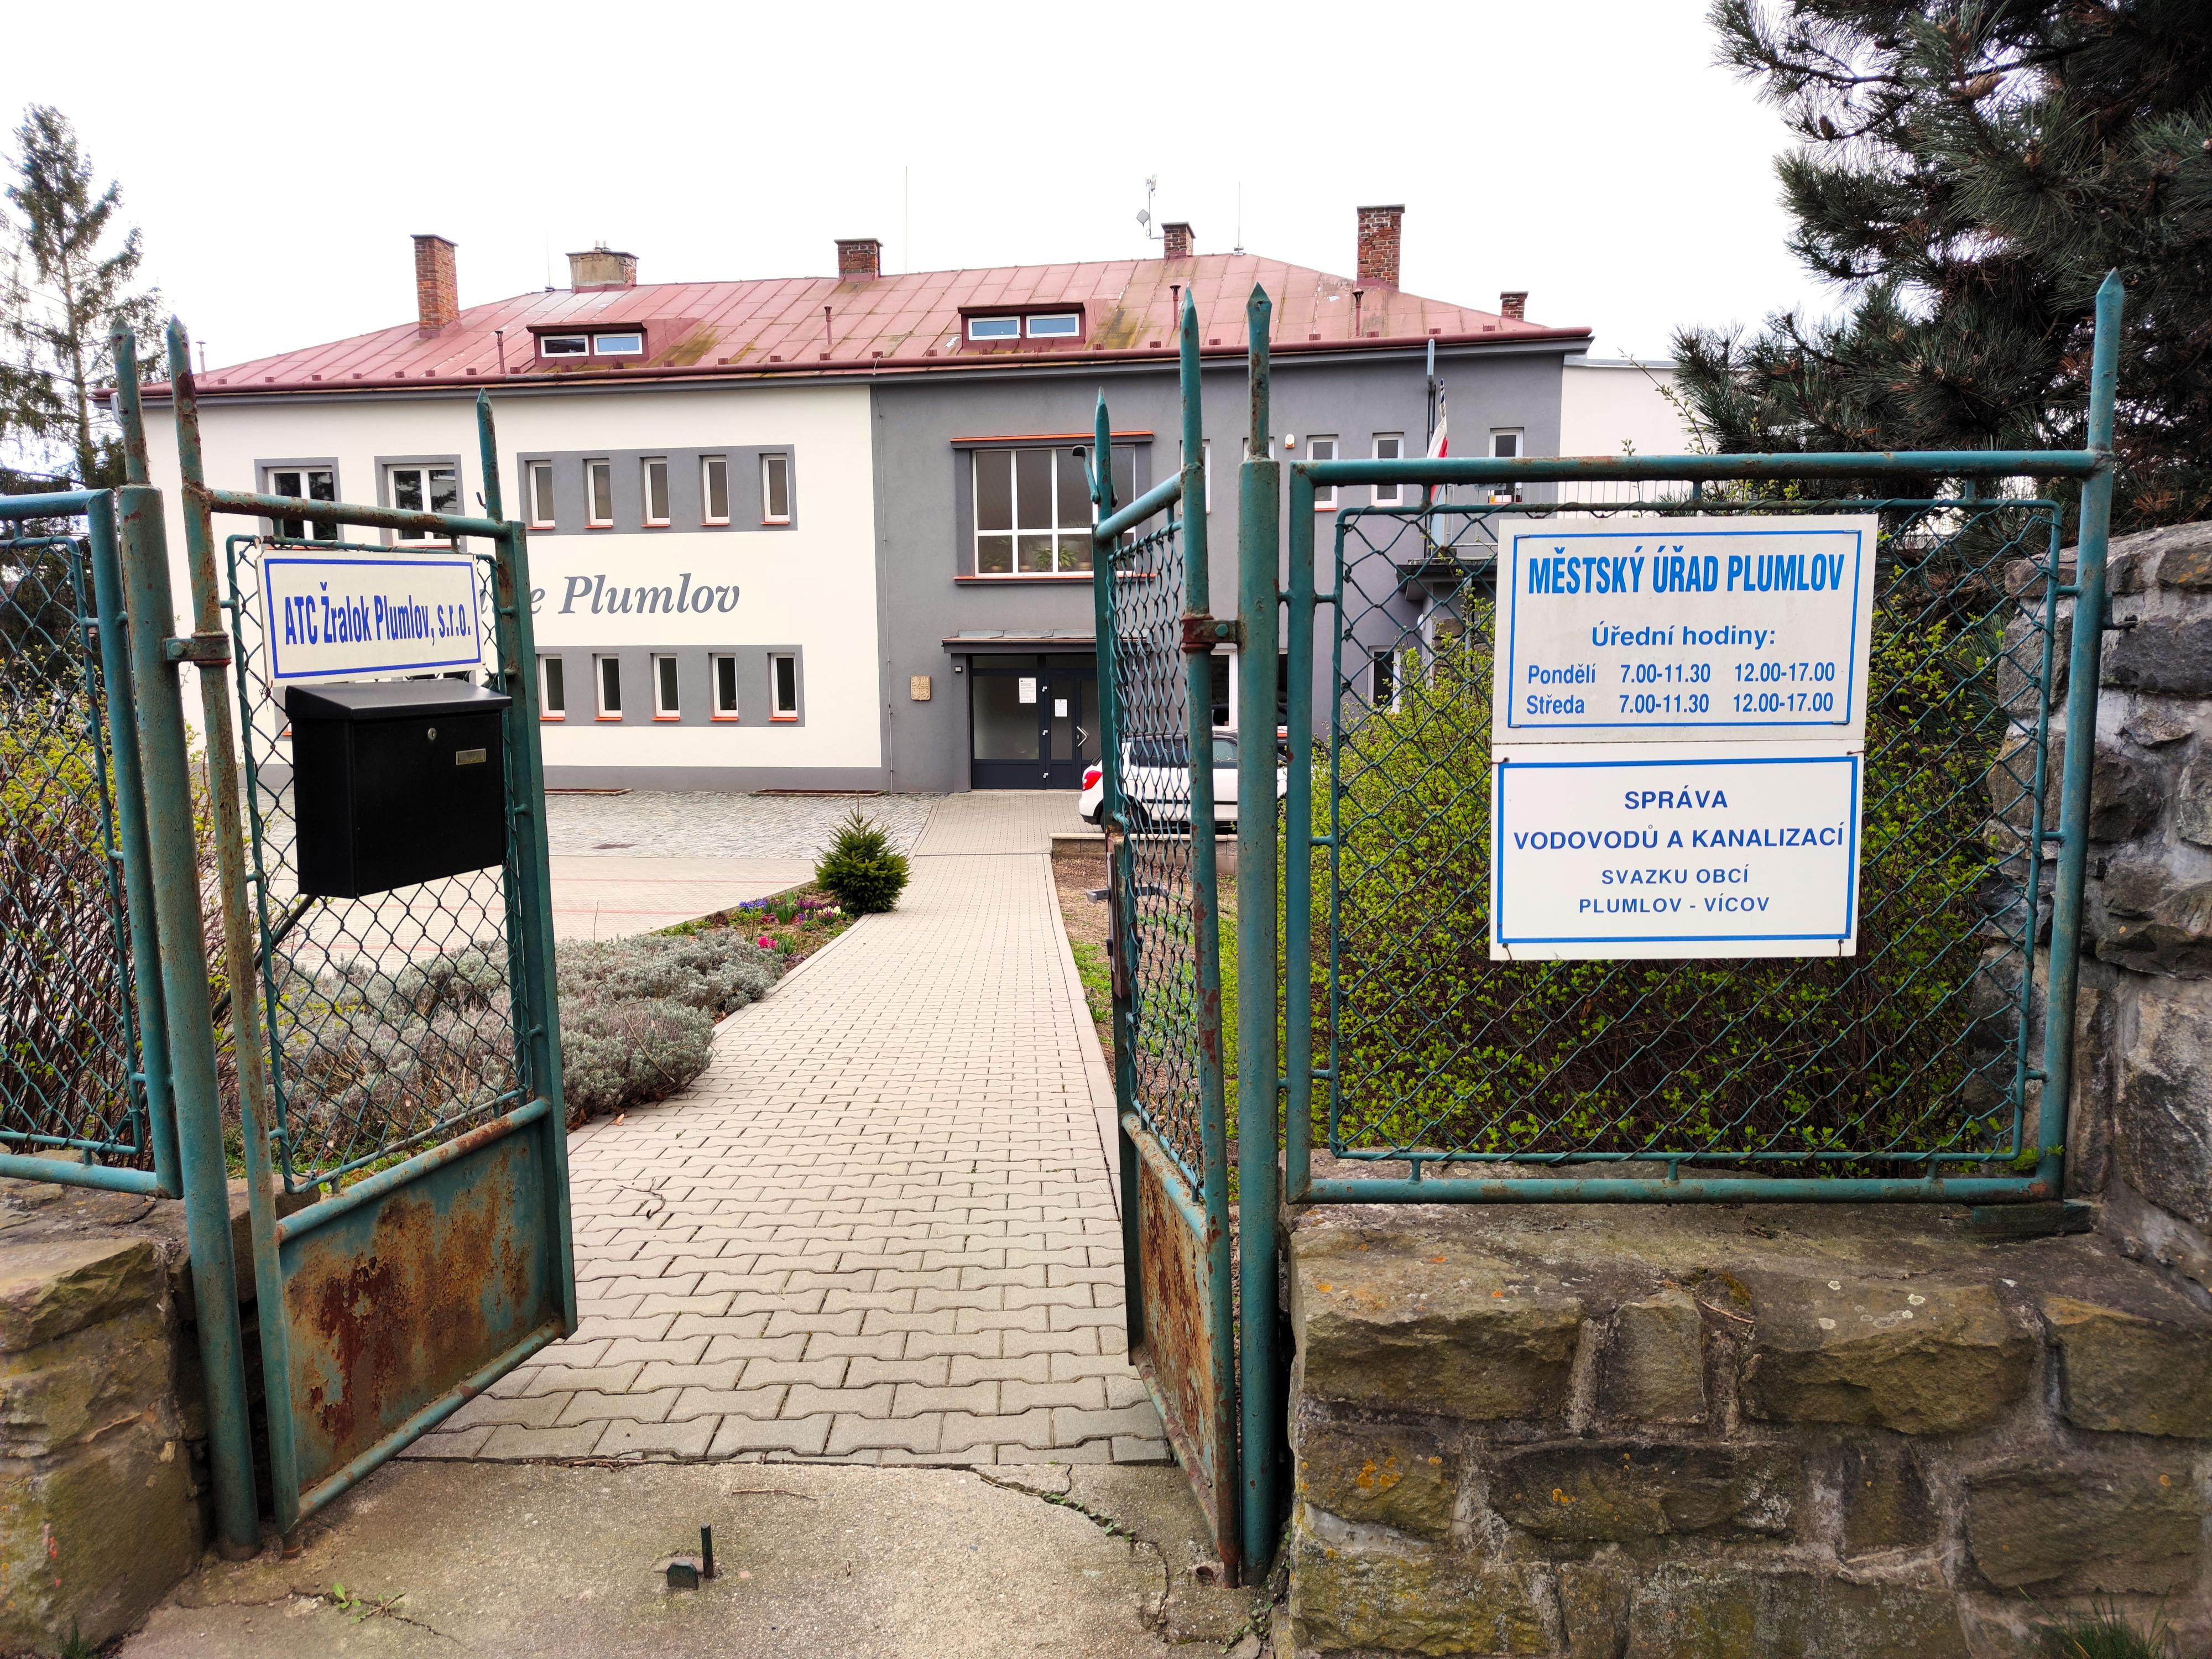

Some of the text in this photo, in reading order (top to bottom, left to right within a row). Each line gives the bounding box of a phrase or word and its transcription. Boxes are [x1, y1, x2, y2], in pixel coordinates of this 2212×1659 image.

[1528, 545, 1845, 594] MĚSTSKÝ ÚŘAD PLUMLOV
[557, 572, 740, 614] Plumlov
[285, 594, 318, 646] ATC
[320, 581, 372, 644] Žralok
[373, 594, 435, 646] Plumlov,
[437, 602, 471, 638] s.r.o.
[1592, 620, 1776, 650] Úřední hodiny:
[1528, 661, 1835, 685] Pondělí 7.00-11.30 12.00-17.00
[1526, 692, 1834, 715] Středa 7.00-11.30 12.00-17.00
[1625, 786, 1728, 810] SPRÁVA
[1514, 822, 1844, 851] VODOVODŮ A KANALIZACÍ
[1601, 865, 1749, 885] SVAZKU OBCÍ
[1579, 898, 1682, 914] PLUMLOV
[1704, 893, 1770, 912] VÍCOV
